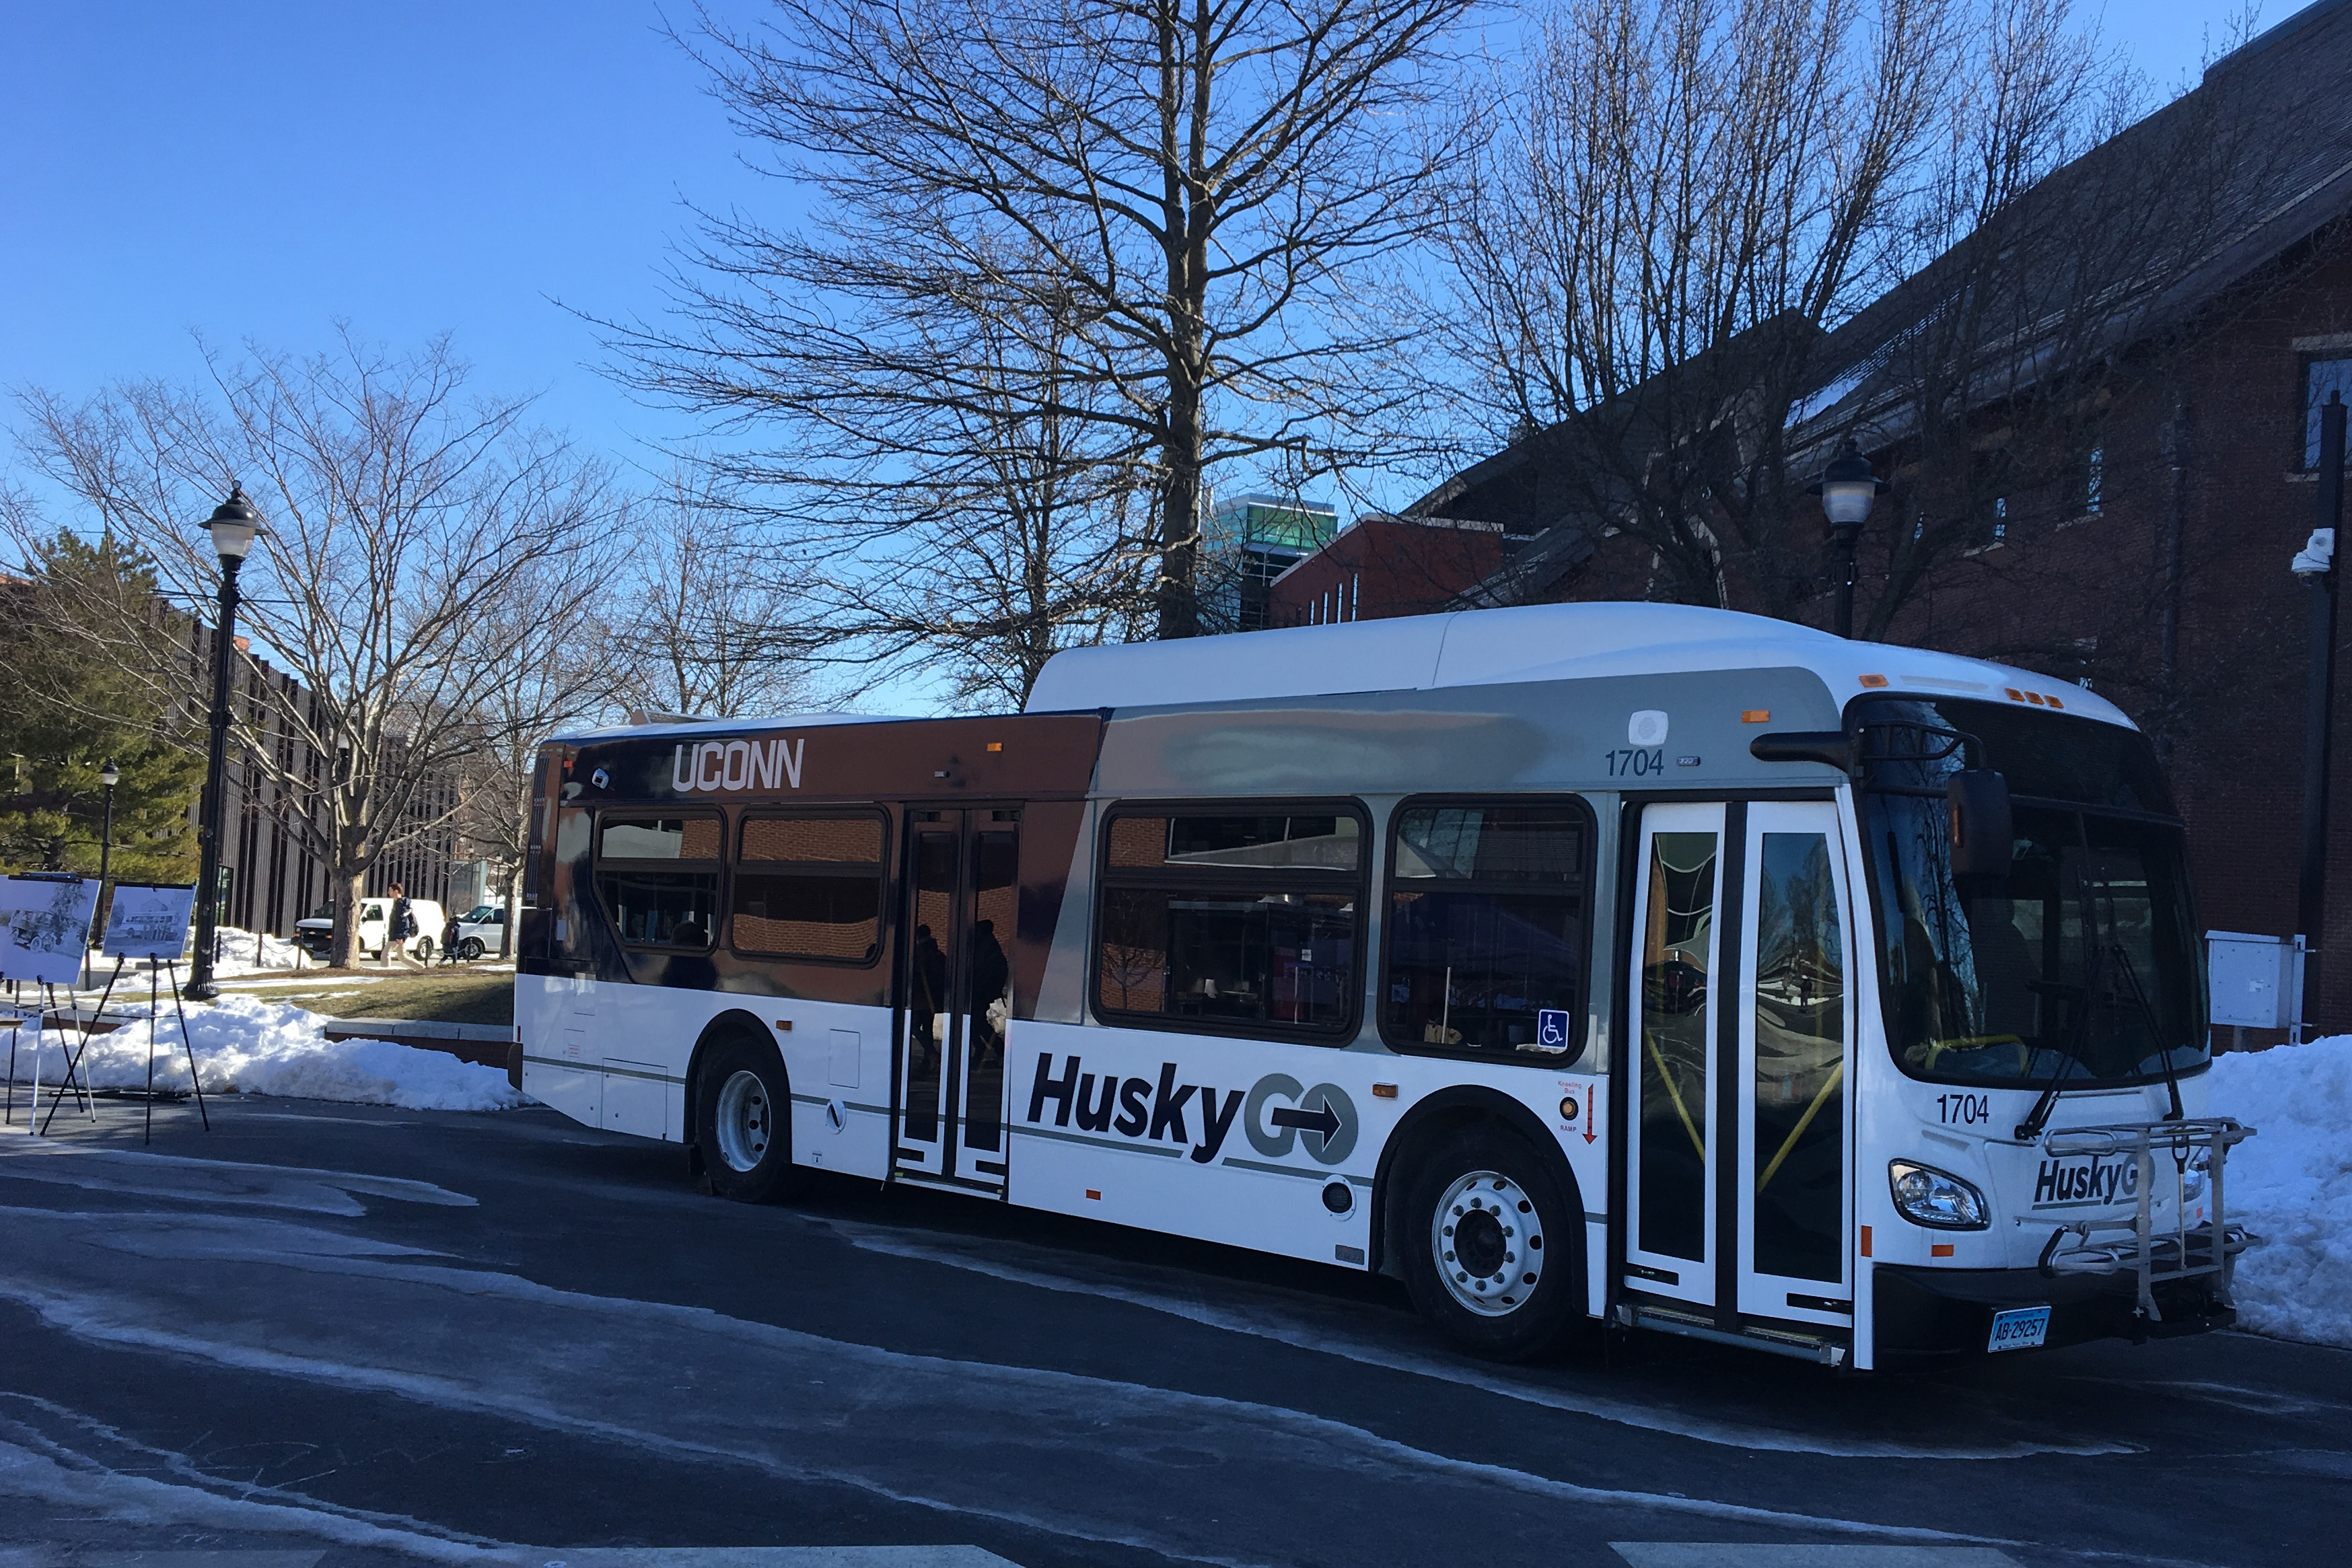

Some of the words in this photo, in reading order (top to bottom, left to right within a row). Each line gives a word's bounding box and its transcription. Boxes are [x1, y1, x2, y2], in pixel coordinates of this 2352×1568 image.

[672, 738, 804, 792] UCONN
[1605, 748, 1664, 777] 1704
[1558, 1080, 1581, 1089] Kneeling
[1027, 1052, 1359, 1165] HuskyGO
[1937, 1094, 1989, 1125] 1704
[2034, 1153, 2155, 1205] HuskyG
